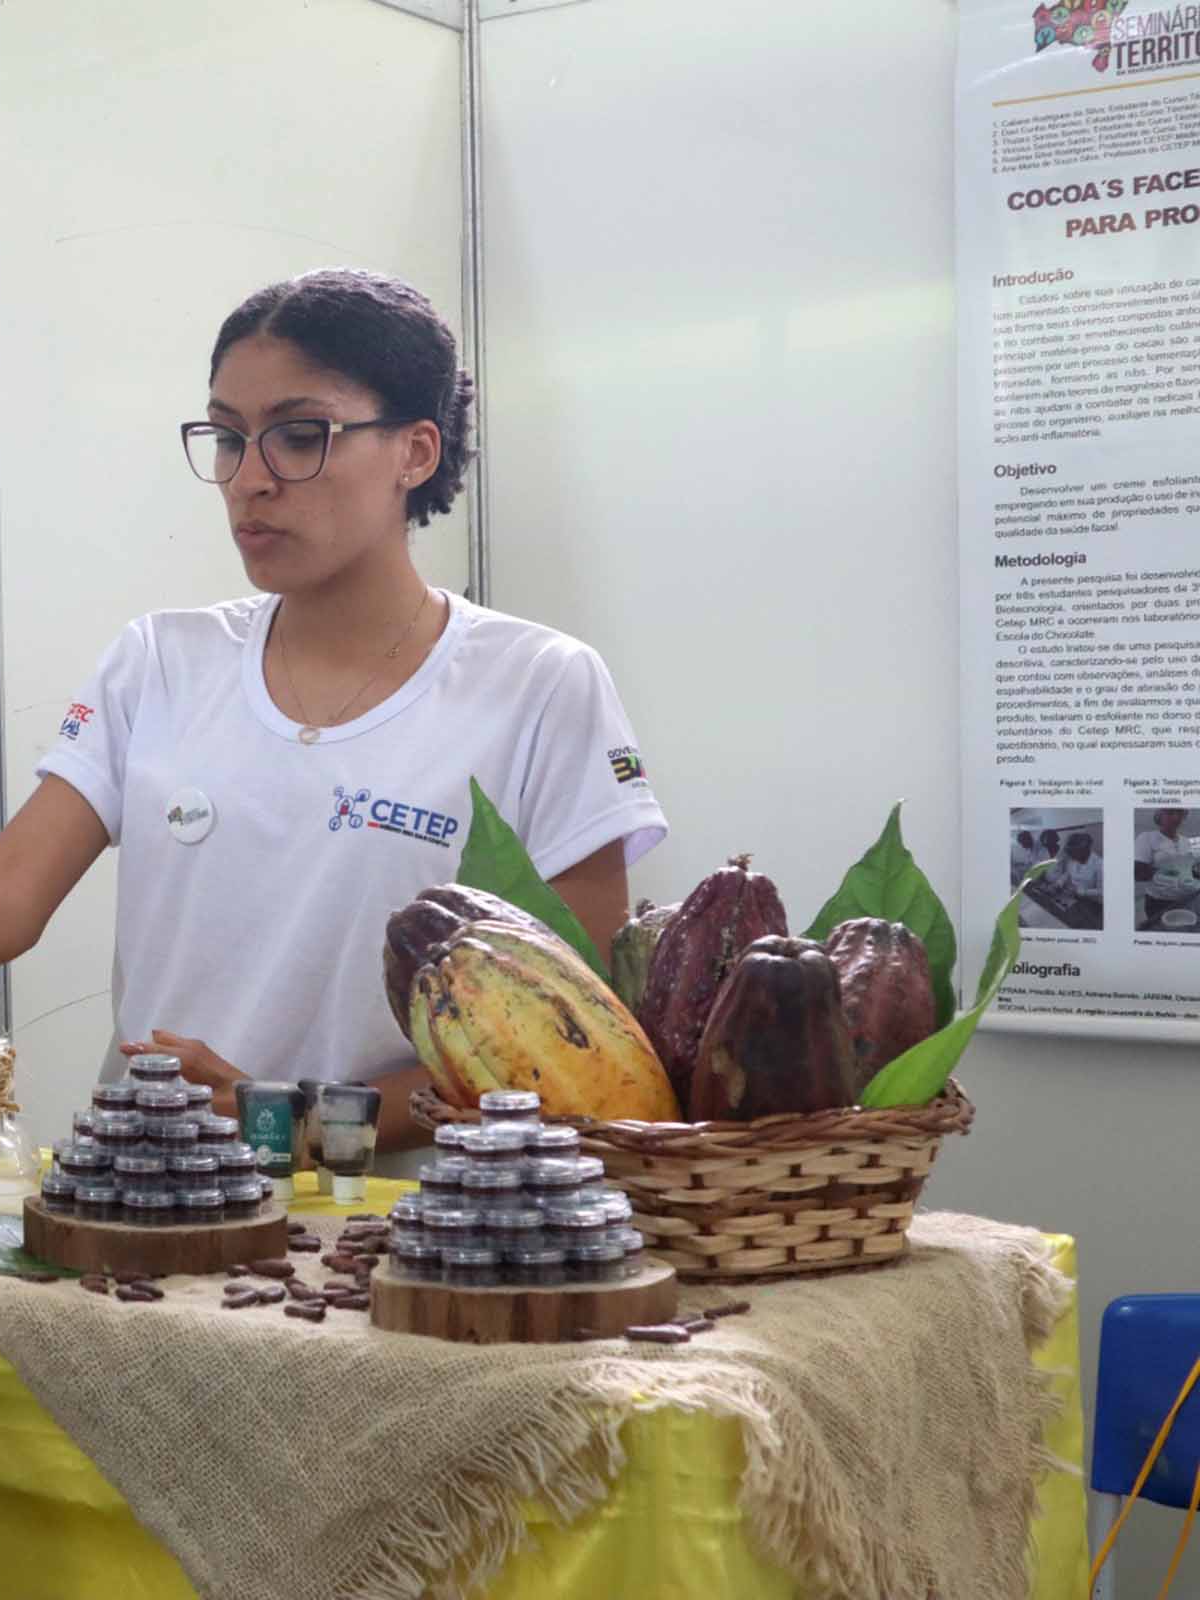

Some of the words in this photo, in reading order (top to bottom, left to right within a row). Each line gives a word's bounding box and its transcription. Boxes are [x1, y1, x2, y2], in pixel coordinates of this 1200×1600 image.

[1065, 212, 1137, 238] PARA
[992, 268, 1074, 289] Introdução
[994, 463, 1057, 480] Objetivo
[1020, 483, 1085, 496] Desenvolver
[994, 552, 1087, 568] Metodologia
[370, 798, 459, 840] CETEP
